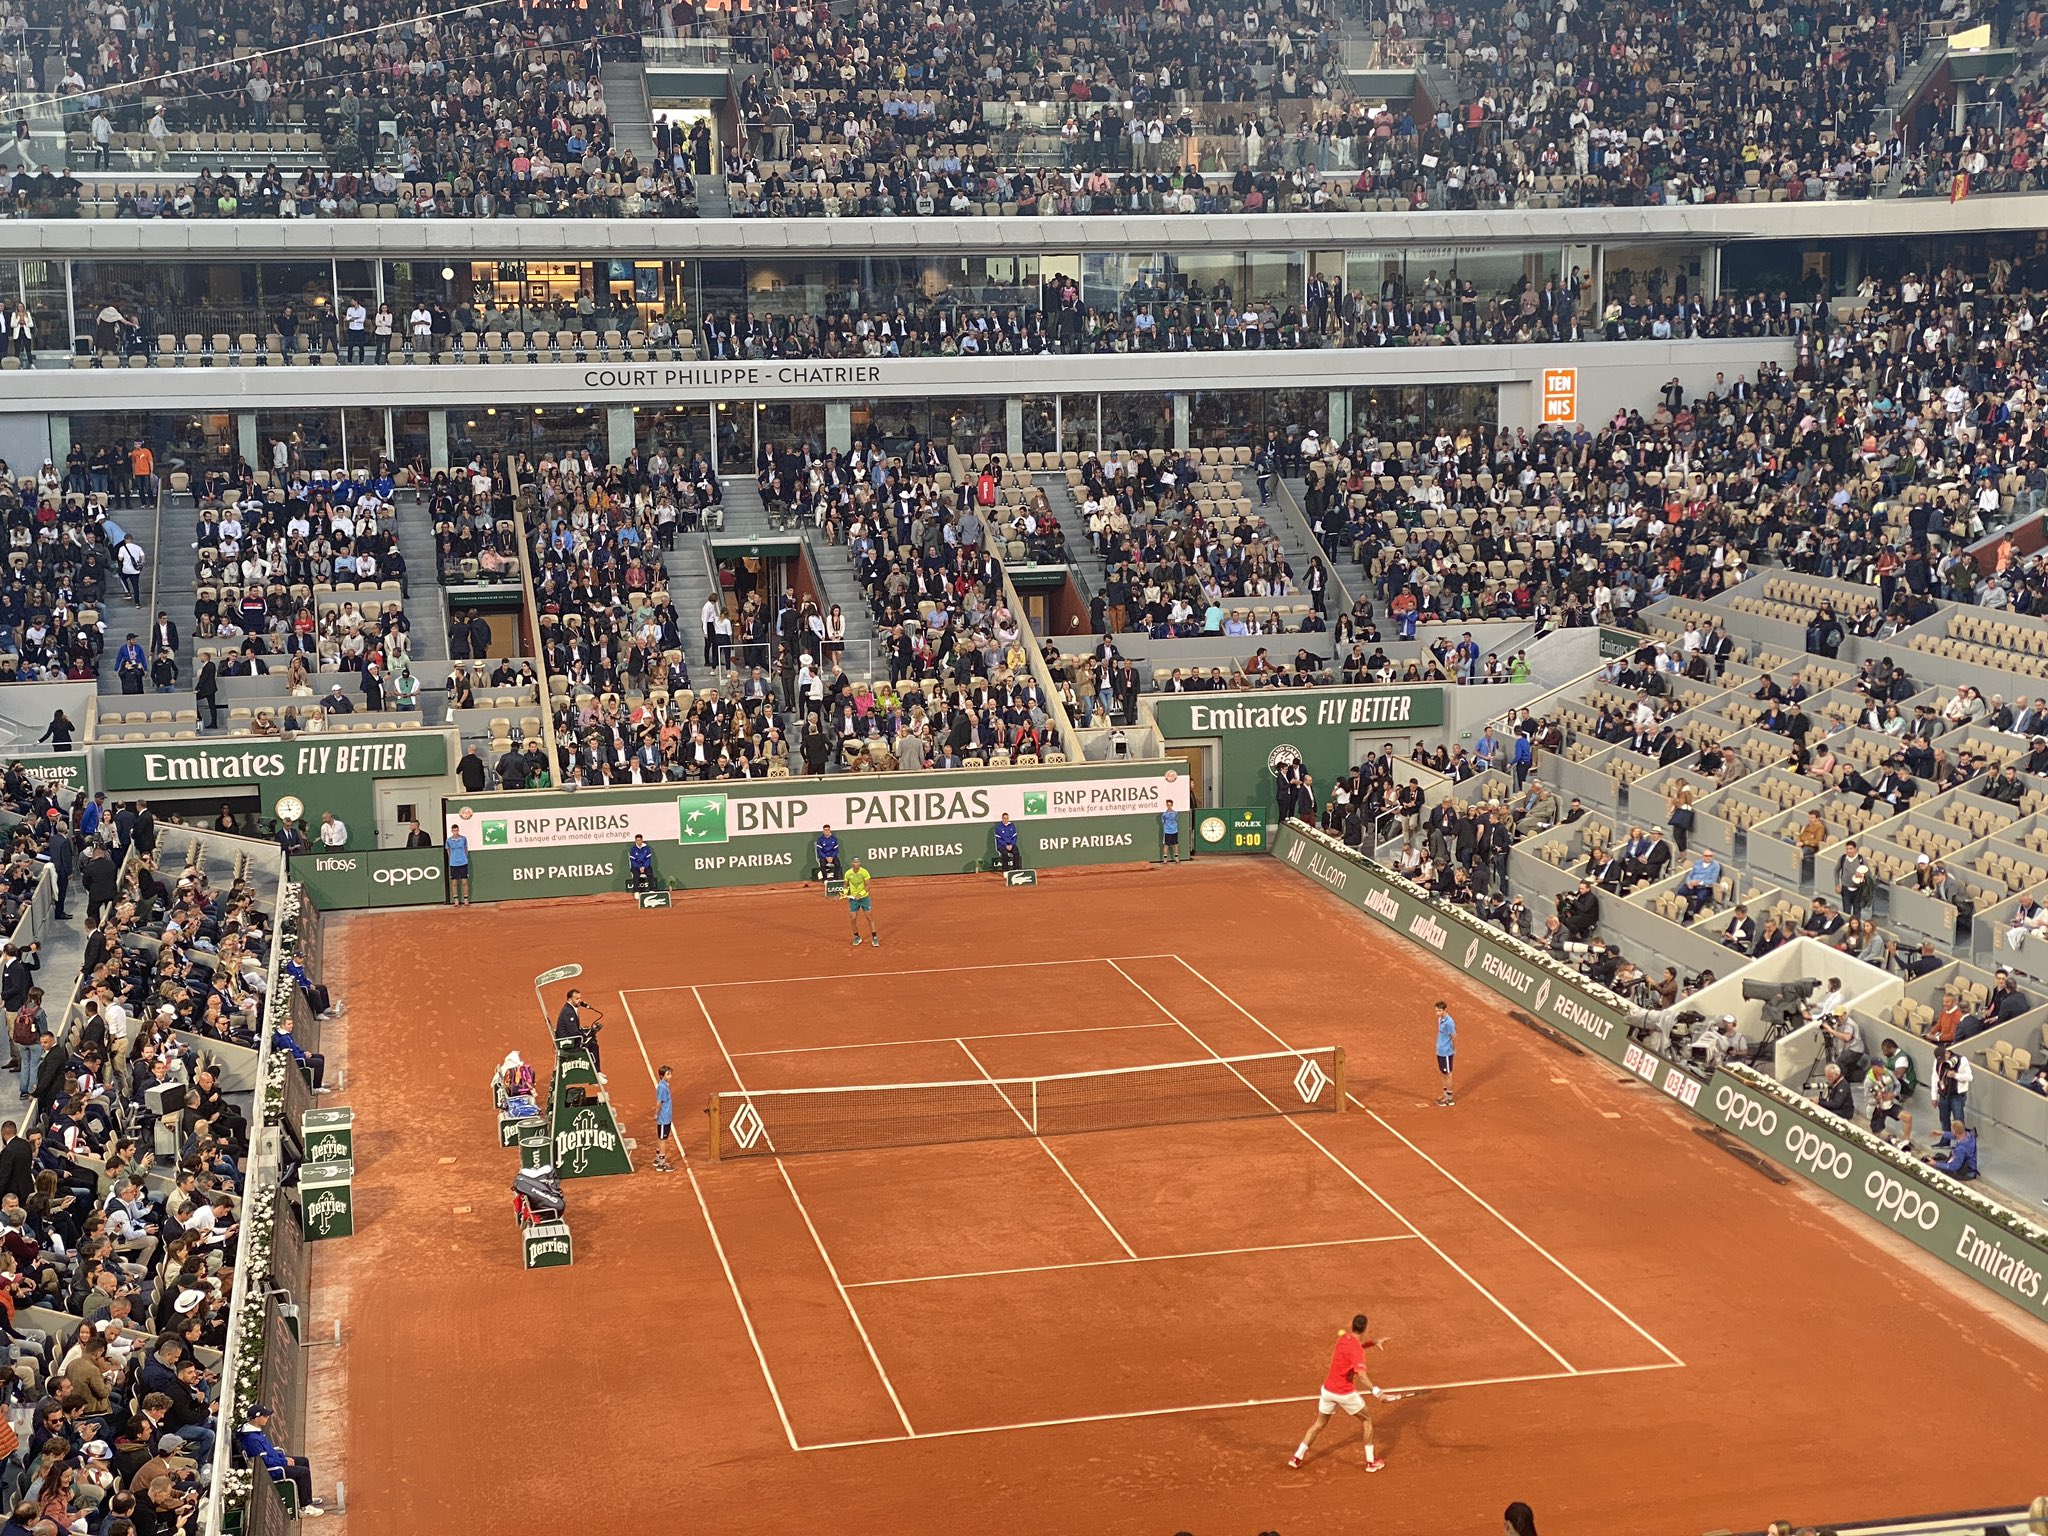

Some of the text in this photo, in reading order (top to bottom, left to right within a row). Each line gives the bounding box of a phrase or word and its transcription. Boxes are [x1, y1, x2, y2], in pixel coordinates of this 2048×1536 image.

[585, 370, 658, 387] COURT
[665, 368, 759, 385] PHILIPPE
[778, 366, 881, 384] CHATRIER
[1548, 375, 1572, 392] TEN
[1548, 399, 1572, 416] NIS
[1190, 695, 1411, 731] Emirates FLY BETTER
[24, 765, 78, 778] mirates
[144, 743, 407, 782] Emirates FLY BETTER
[1053, 785, 1159, 805] BNP PARIBAS
[737, 789, 991, 831] BNP PARIBAS
[1068, 805, 1085, 813] bank
[1086, 804, 1097, 813] for
[1105, 803, 1137, 811] changing
[515, 813, 630, 834] BNP PARIBAS
[1234, 820, 1262, 828] ROLEX
[524, 835, 550, 843] banque
[568, 832, 592, 840] monde
[593, 831, 605, 839] qui
[605, 830, 631, 839] change
[1039, 833, 1133, 851] BNP PARIBAS
[1235, 833, 1261, 847] 0:00
[694, 852, 793, 870] BNP PARIBAS
[868, 842, 963, 860] BNP PARIBAS
[316, 857, 357, 872] Infosys
[512, 862, 614, 881] BNP PARIBAS
[1307, 852, 1347, 889] ALL.com
[373, 866, 441, 886] oppo
[1363, 887, 1400, 922] LAVAZZA
[1409, 914, 1448, 950] LAVAZZA
[1481, 952, 1534, 994] RENAULT
[1553, 994, 1614, 1041] RENAULT
[561, 1057, 590, 1079] perrier
[1626, 1048, 1656, 1077] 03:11
[1667, 1072, 1698, 1102] 03:11
[1716, 1085, 1778, 1137] oppo
[311, 1143, 348, 1163] perrier
[555, 1124, 616, 1169] perrier
[1785, 1124, 1853, 1180] oppo
[1864, 1169, 1940, 1231] oppo
[307, 1200, 347, 1226] perrier
[529, 1238, 569, 1267] perrier
[1955, 1224, 2042, 1298] Emirates
